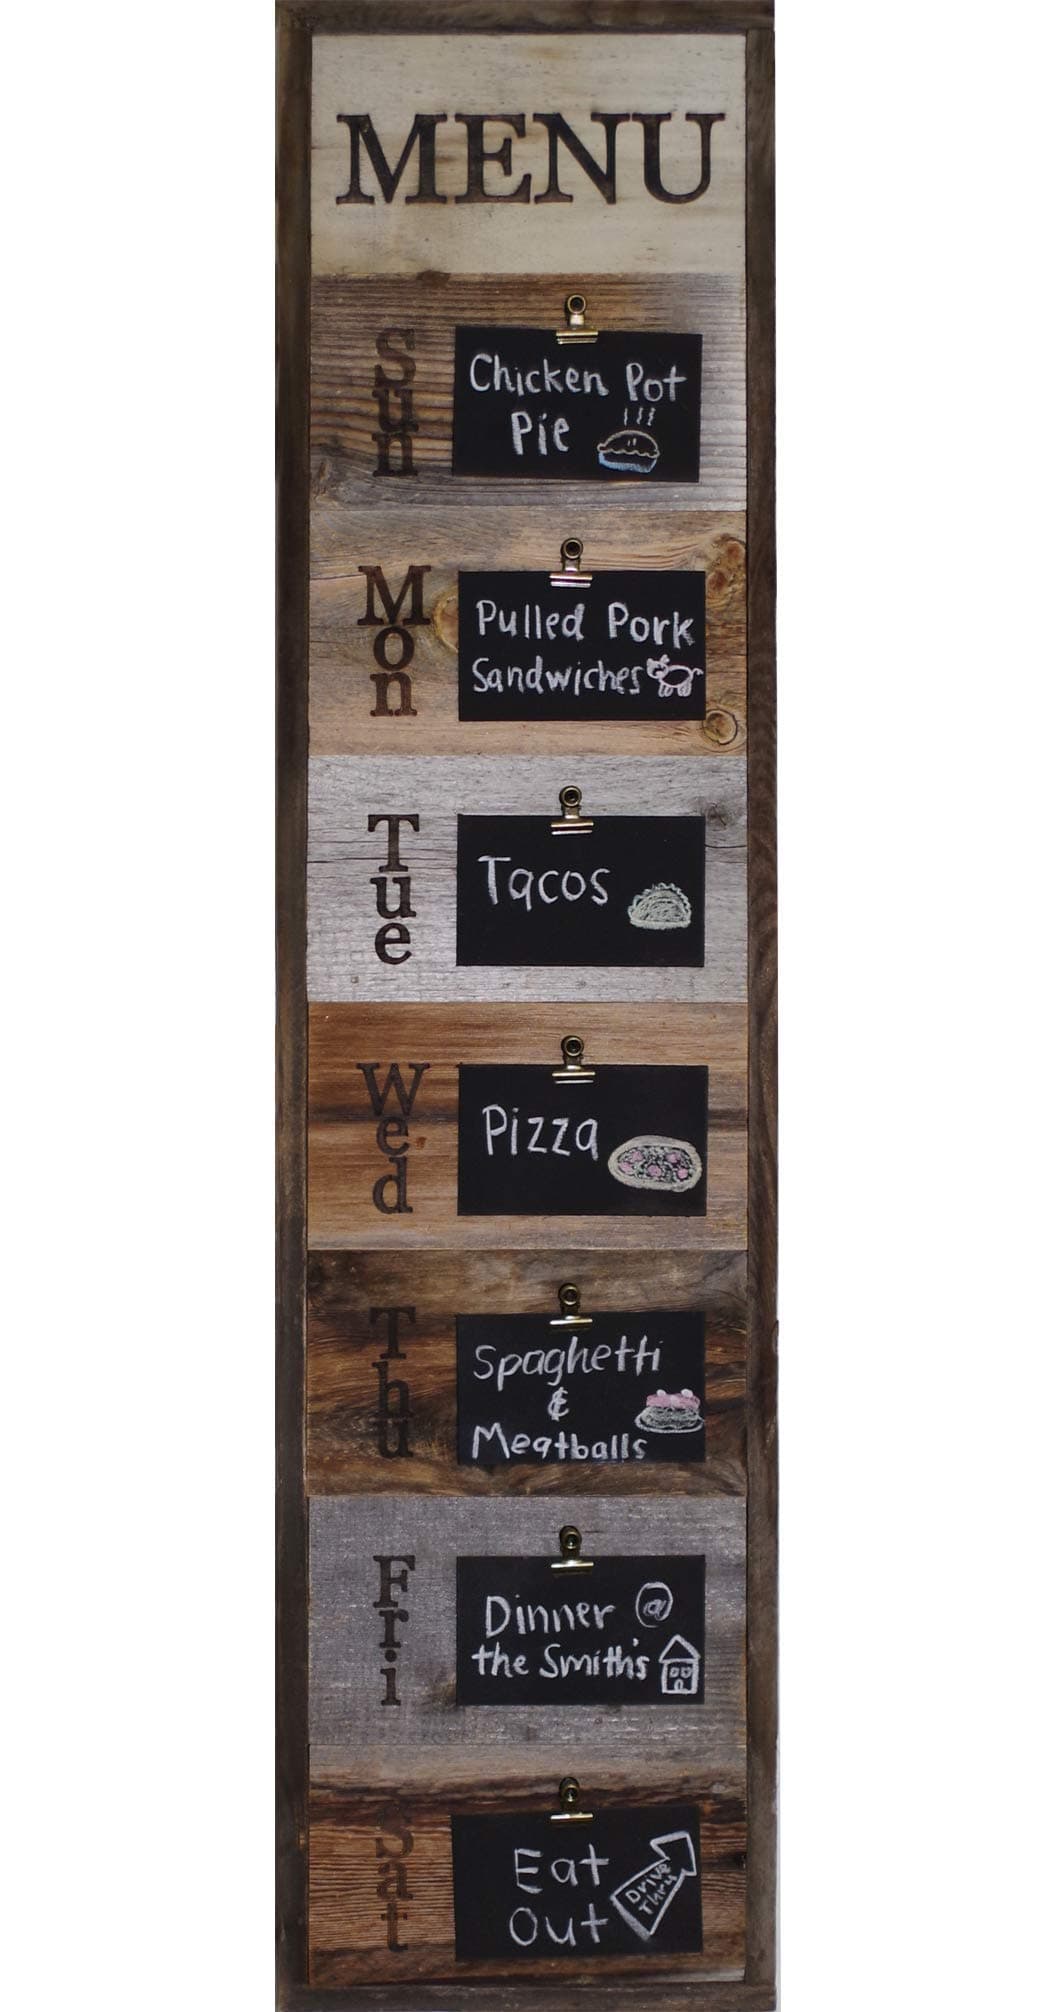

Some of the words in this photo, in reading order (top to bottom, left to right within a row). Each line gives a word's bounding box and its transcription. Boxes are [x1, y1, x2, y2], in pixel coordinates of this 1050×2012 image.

[336, 112, 726, 205] MENU
[371, 327, 418, 478] Sun
[469, 352, 609, 396] Chicken
[625, 362, 688, 402] Pot
[510, 410, 570, 456] Pie
[356, 564, 432, 717] Mon
[475, 599, 585, 641] Pulled
[607, 601, 696, 648] Pork
[471, 655, 642, 696] Sandwiches
[367, 813, 420, 966] Tue
[477, 855, 611, 911] Tacos
[356, 1061, 430, 1215] Wed
[481, 1104, 600, 1161] Pizza
[369, 1305, 416, 1459] Thu
[472, 1335, 664, 1391] Spaghetti
[471, 1421, 648, 1460] Meatballs
[372, 1554, 416, 1706] Fri
[484, 1594, 616, 1638] Dinner
[470, 1640, 530, 1679] the
[538, 1637, 651, 1681] Smith's
[513, 1843, 610, 1894] Eat
[508, 1902, 609, 1947] Out
